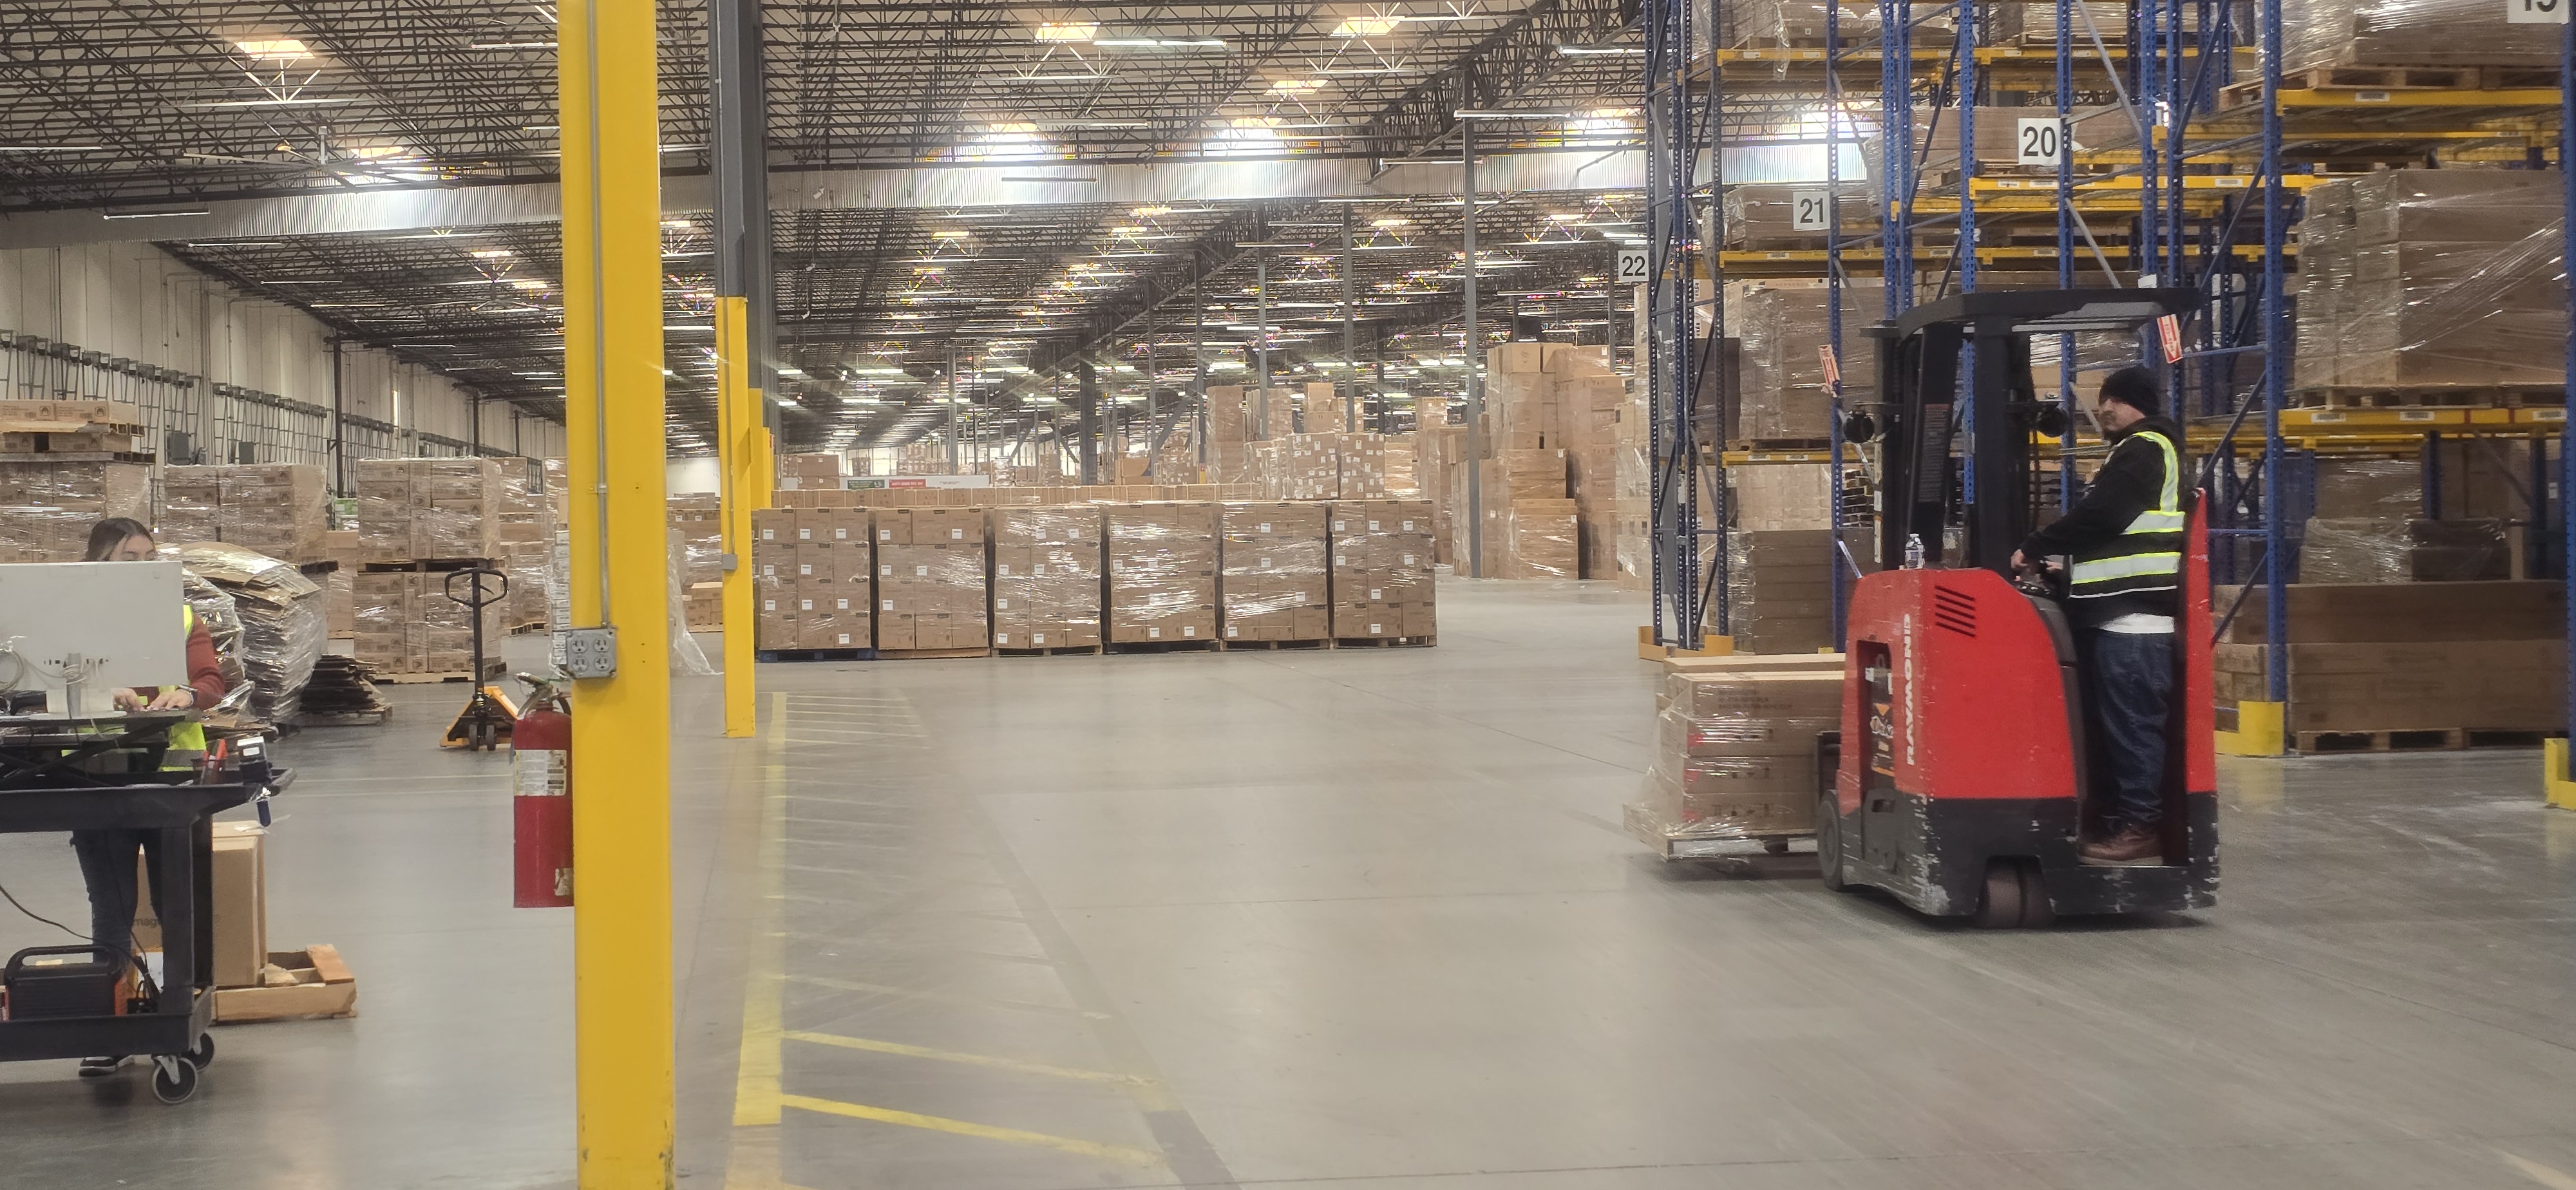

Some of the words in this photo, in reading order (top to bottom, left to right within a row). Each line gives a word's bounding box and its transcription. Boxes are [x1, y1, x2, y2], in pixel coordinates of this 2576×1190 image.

[2023, 126, 2056, 157] 20
[1799, 197, 1824, 223] 21
[1622, 256, 1645, 277] 22
[1903, 613, 1915, 766] RAYMOND
